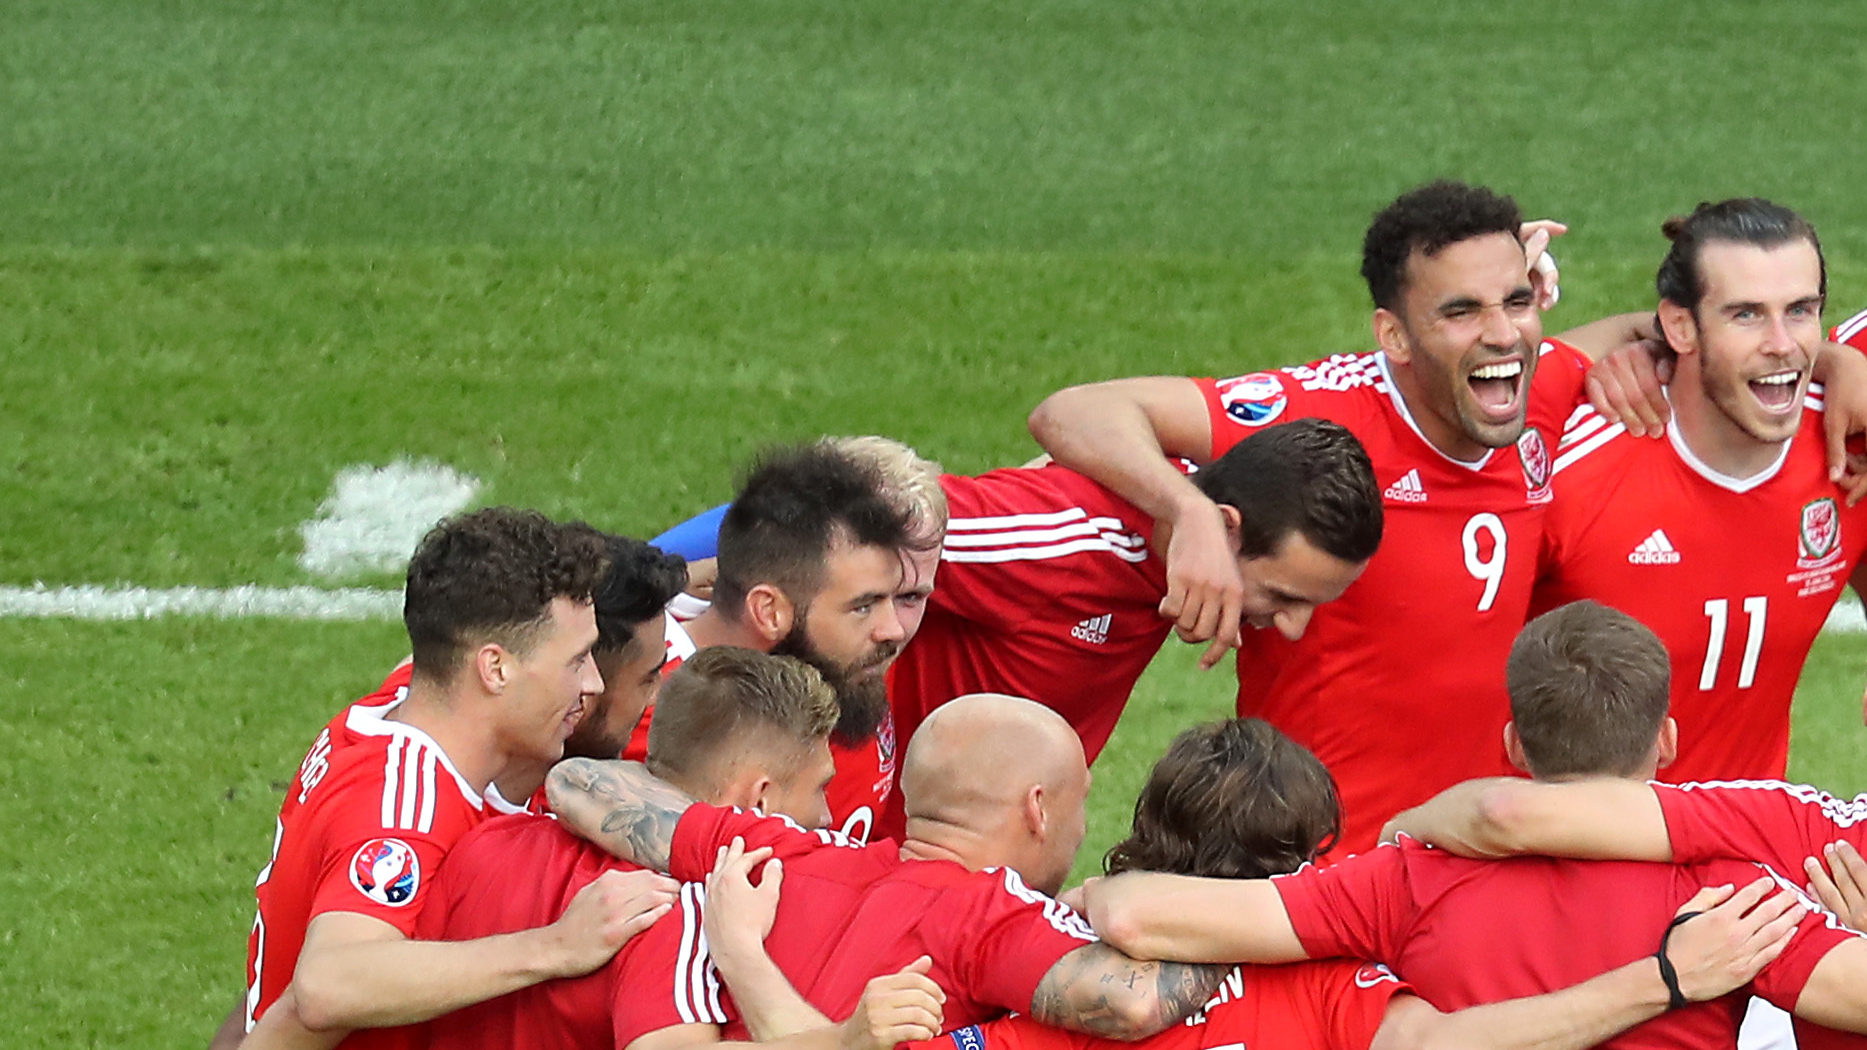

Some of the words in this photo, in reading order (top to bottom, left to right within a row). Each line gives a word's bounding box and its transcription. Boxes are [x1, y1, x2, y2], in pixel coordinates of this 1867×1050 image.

[1384, 486, 1428, 503] adidas
[1461, 511, 1508, 612] 9
[1628, 550, 1682, 565] adidas
[1698, 596, 1768, 692] 11
